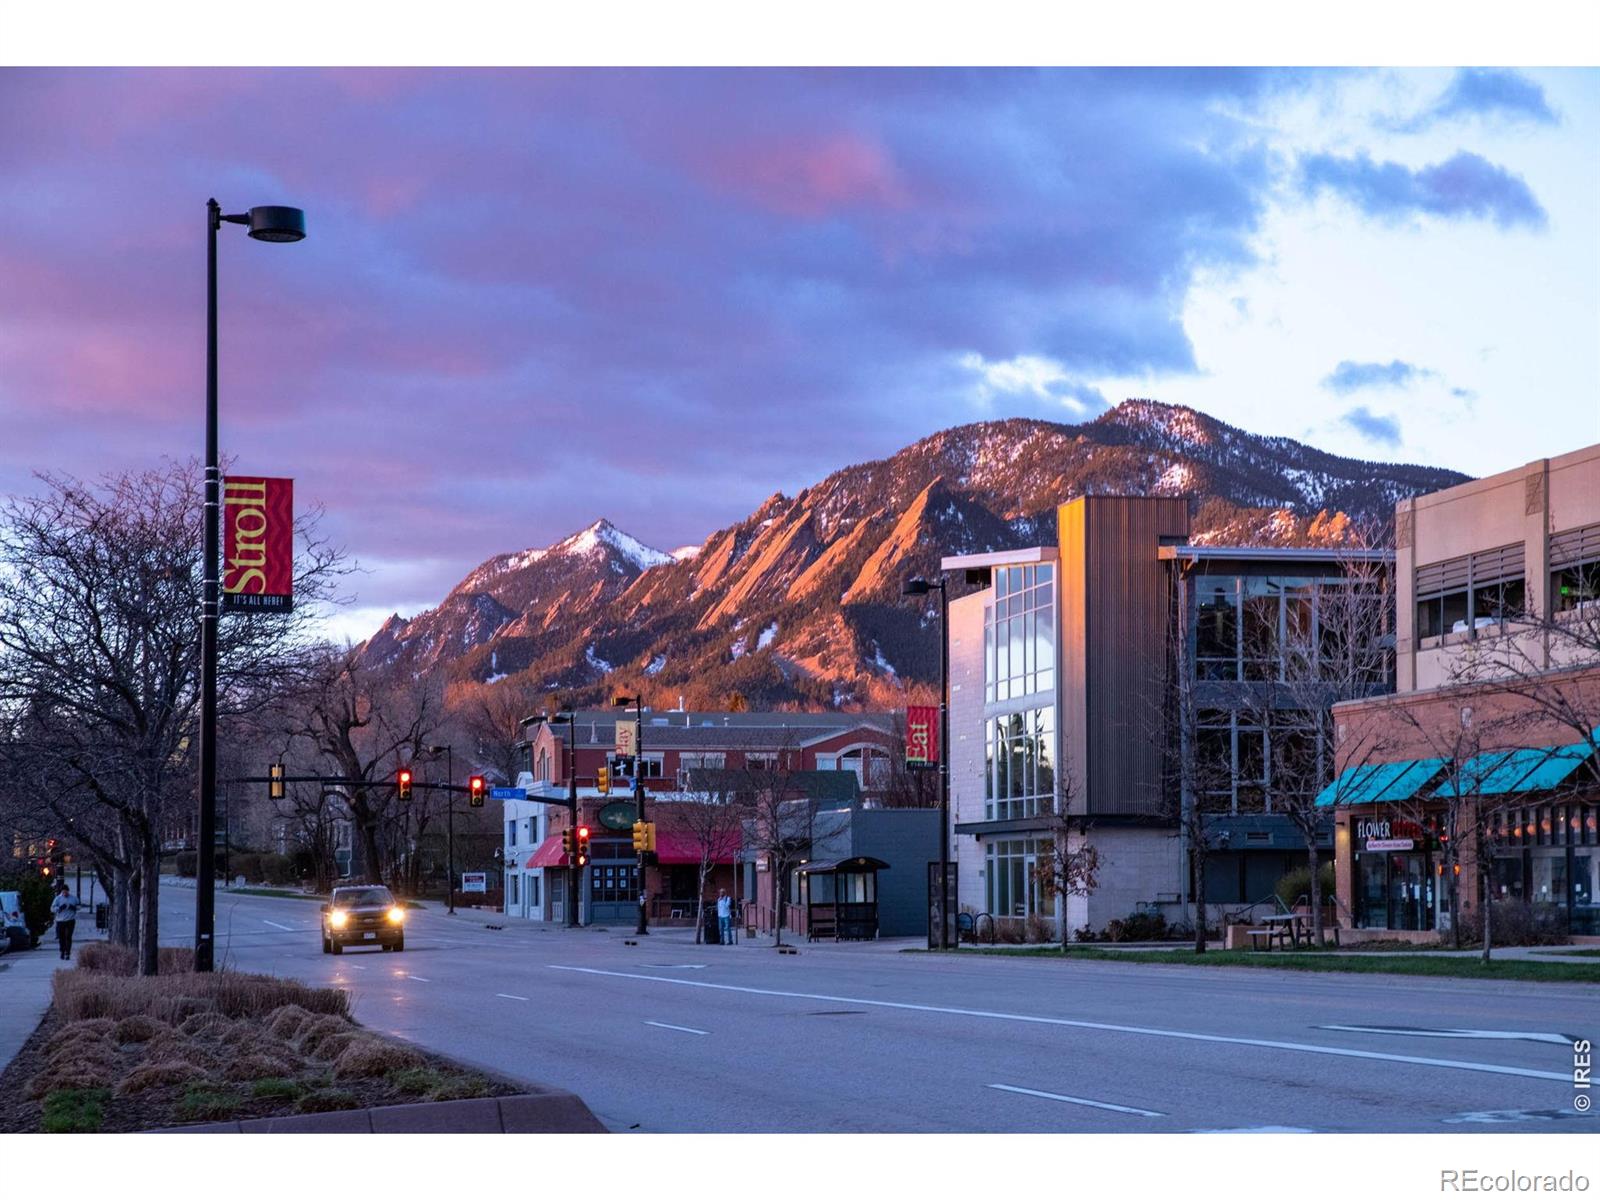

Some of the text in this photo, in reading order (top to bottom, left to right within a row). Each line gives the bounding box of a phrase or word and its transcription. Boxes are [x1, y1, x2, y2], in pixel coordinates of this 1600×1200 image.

[224, 480, 266, 594] Stroll
[249, 595, 261, 606] ALL
[616, 728, 633, 757] Play
[906, 721, 928, 762] Eat
[1357, 821, 1391, 838] FLOWER
